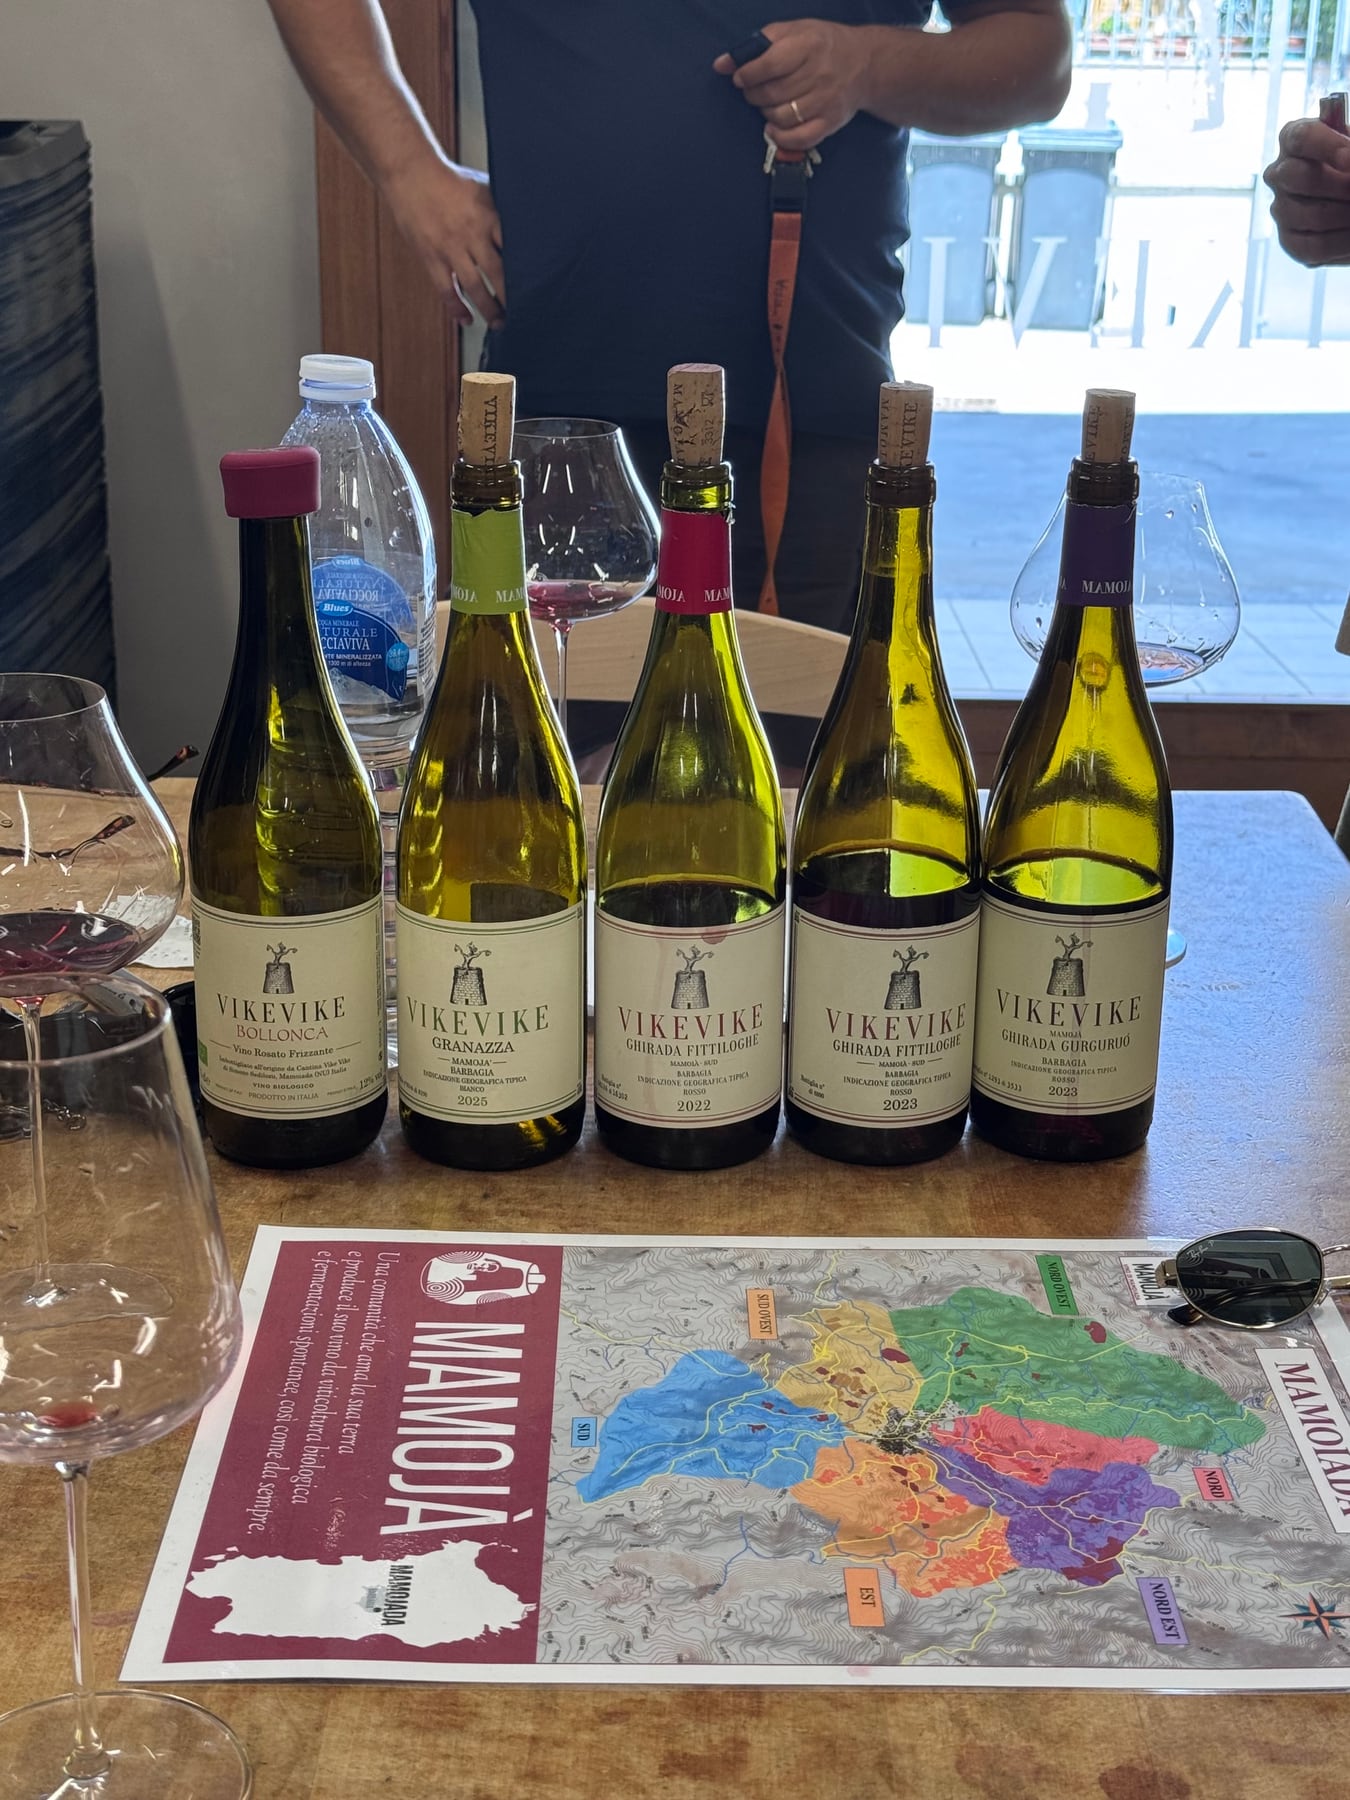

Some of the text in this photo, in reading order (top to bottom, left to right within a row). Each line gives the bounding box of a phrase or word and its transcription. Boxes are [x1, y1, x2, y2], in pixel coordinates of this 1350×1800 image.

[481, 395, 498, 465] VIKEVI
[899, 402, 918, 465] EVIKE
[1085, 404, 1100, 461] EVIKE
[704, 586, 730, 602] MAM
[323, 603, 349, 612] Blues
[322, 627, 378, 637] TURALE
[321, 638, 370, 651] CCIAVIVA
[217, 993, 345, 1024] VIKEVIKE
[406, 996, 549, 1036] VIKEVIKE
[996, 988, 1141, 1027] VIKEVIKE
[618, 1003, 763, 1040] VIKEVIKE
[826, 1003, 966, 1040] VIKEVIKE
[236, 1024, 329, 1042] BOLLONCA
[1001, 1028, 1056, 1051] GHIRADA
[233, 1044, 334, 1058] Vino Rosato Frizzante
[432, 1036, 515, 1053] GRANAZZA
[626, 1033, 759, 1056] GHIRADA FITTILOGHE
[833, 1033, 961, 1057] GHIRADA FITTILOGHE
[331, 1066, 347, 1074] Italia
[450, 1067, 494, 1076] BARBAGIA
[1011, 1060, 1117, 1075] INDICAZIONE GEOGRAFICA TIPICA
[1042, 1057, 1087, 1067] BARBAGIA
[423, 1069, 527, 1085] INDICAZIONE GEOGRAFICA TIPICA
[637, 1072, 749, 1086] INDICAZIONE GEOGRAFICA TIPICA
[677, 1069, 712, 1077] BARBAGIA
[843, 1072, 952, 1087] INDICAZIONE GEOGRAFICA TIPICA
[885, 1070, 919, 1078] BARBAGIA
[249, 1092, 286, 1100] PRODOTTO
[297, 1092, 319, 1100] ITALIA
[457, 1095, 488, 1106] 2025
[683, 1088, 706, 1096] ROSSO
[890, 1088, 913, 1096] ROSSO
[1048, 1086, 1078, 1097] 2023
[677, 1100, 711, 1112] 2022
[883, 1098, 918, 1110] 2023
[338, 1258, 366, 1301] produce
[1046, 1261, 1071, 1309] NORD OVEST
[298, 1258, 338, 1333] fermentazioni
[331, 1313, 349, 1333] suo
[757, 1294, 772, 1335] SUD OVEST
[325, 1335, 349, 1359] vino
[338, 1252, 400, 1454] Una comunità che ama la sua terra
[277, 1335, 315, 1397] spontanee,
[321, 1361, 348, 1376] da
[275, 1399, 299, 1422] così
[305, 1379, 339, 1442] viticoltura
[379, 1321, 534, 1535] MAMOJÀ
[578, 1423, 591, 1441] SUD
[266, 1425, 289, 1459] come
[261, 1461, 291, 1479] da
[290, 1446, 330, 1504] biologica
[1203, 1469, 1225, 1499] NORD
[246, 1482, 276, 1535] sempre.
[860, 1587, 876, 1607] EST
[1150, 1581, 1181, 1640] NORD EST
